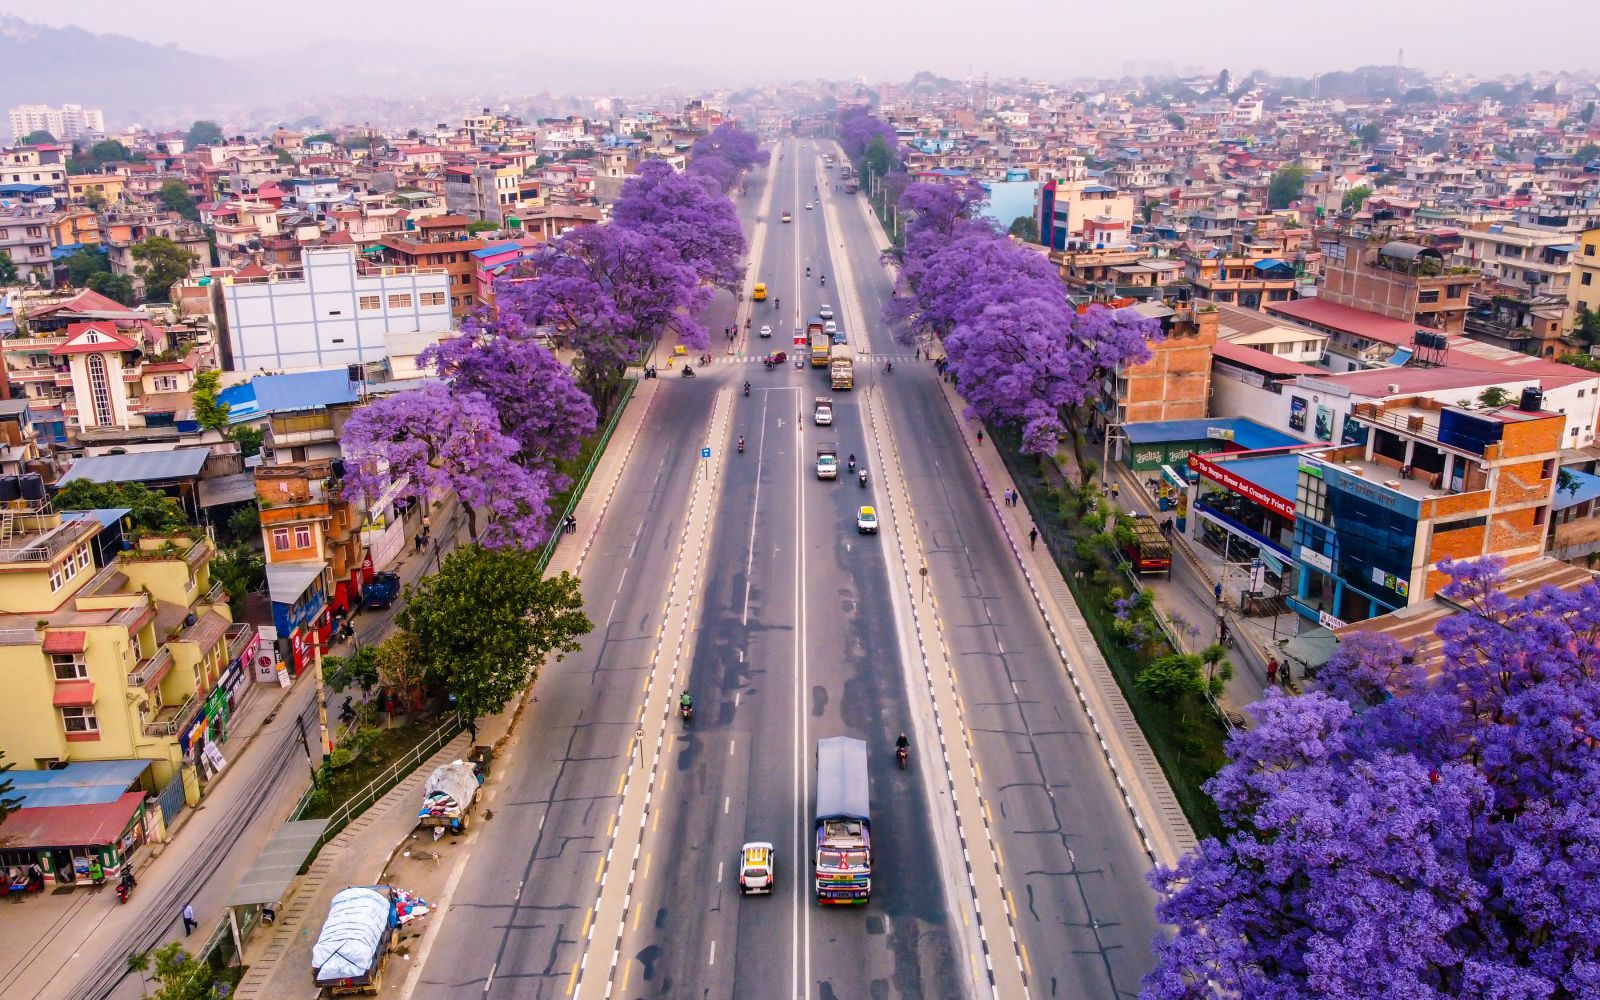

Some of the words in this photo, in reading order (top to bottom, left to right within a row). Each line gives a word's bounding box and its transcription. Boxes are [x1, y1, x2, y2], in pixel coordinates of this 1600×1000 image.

[1199, 463, 1208, 472] The
[1208, 466, 1223, 480] Burger
[1223, 474, 1238, 487] House
[1239, 482, 1249, 493] And
[1249, 487, 1270, 505] Crunchy
[1271, 499, 1285, 511] Fried
